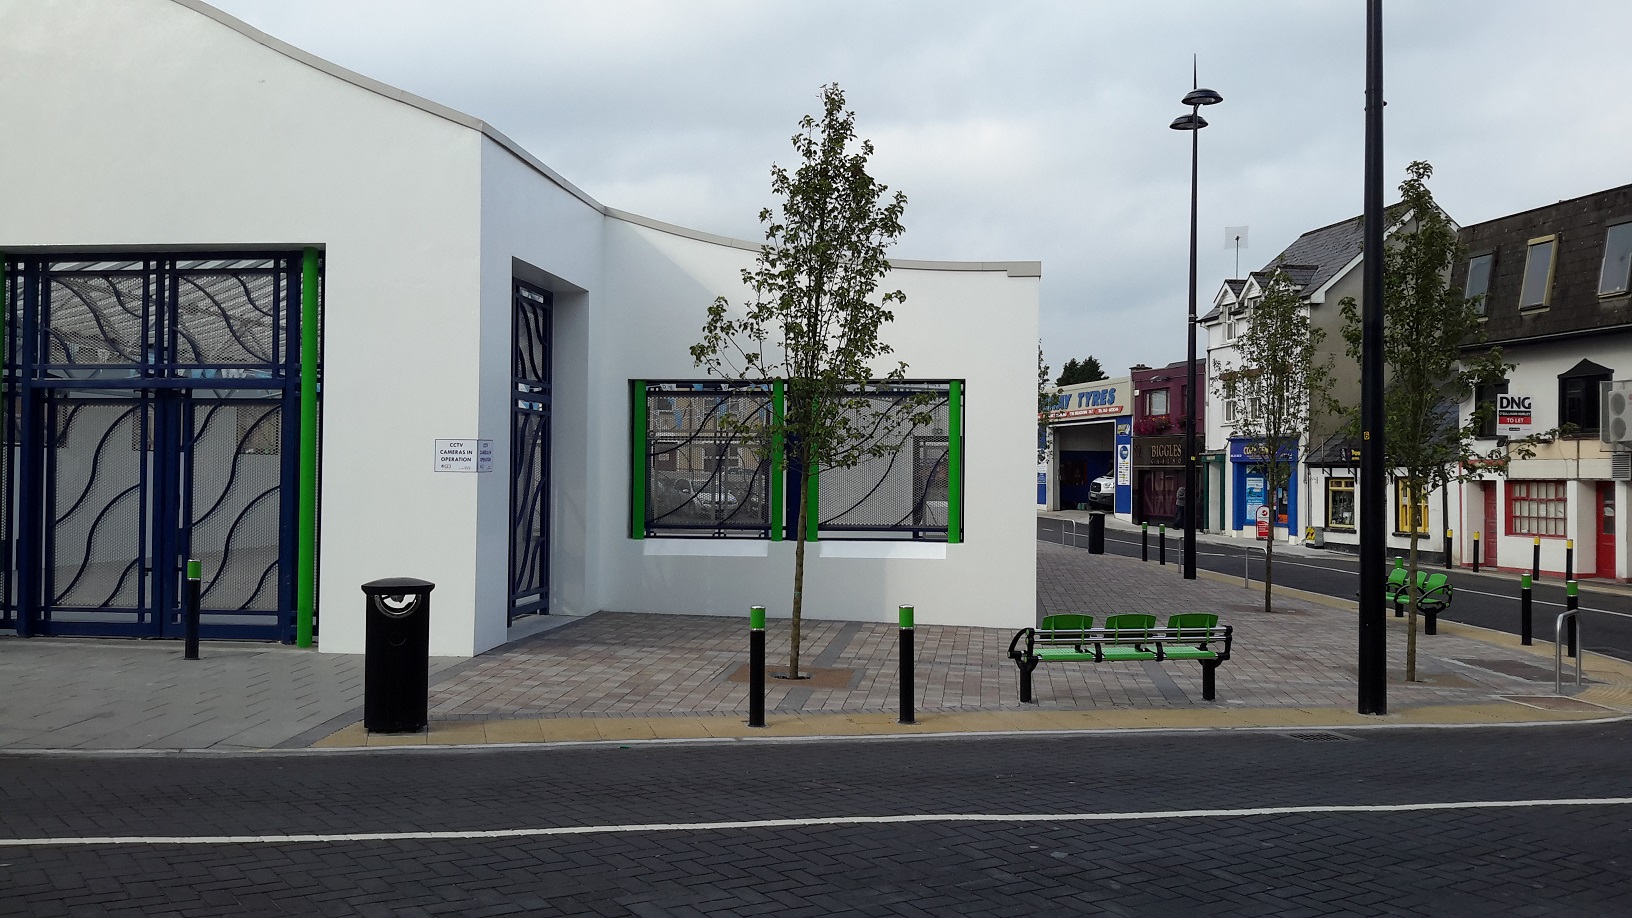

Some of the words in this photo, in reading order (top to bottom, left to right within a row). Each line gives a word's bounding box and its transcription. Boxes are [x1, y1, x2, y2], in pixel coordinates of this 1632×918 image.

[1077, 387, 1117, 408] TYRES
[1499, 396, 1532, 409] DNG
[1151, 443, 1182, 457] BIGGLES
